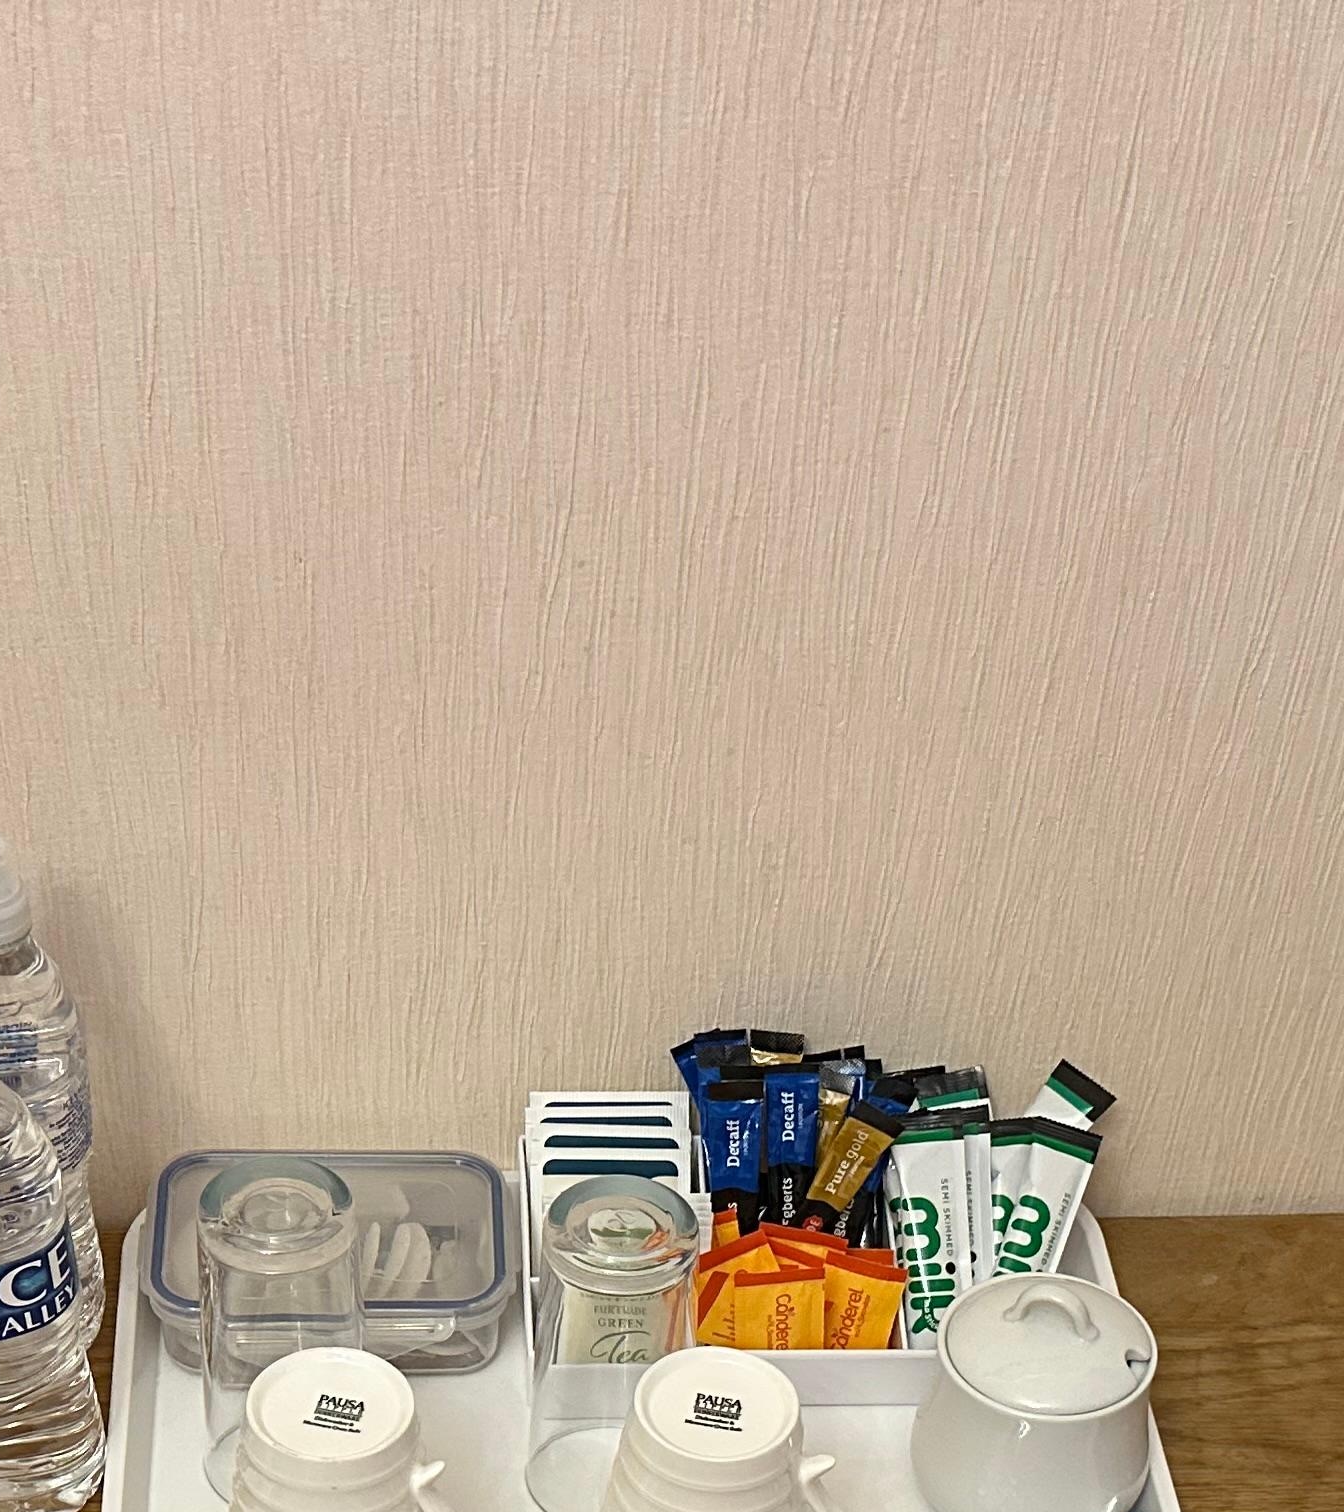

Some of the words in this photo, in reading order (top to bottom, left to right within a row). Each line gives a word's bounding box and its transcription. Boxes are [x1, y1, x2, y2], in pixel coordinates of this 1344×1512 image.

[781, 1092, 795, 1142] Decaff
[727, 1120, 740, 1167] Decaff
[825, 1160, 850, 1195] Pure
[846, 1128, 869, 1160] gold
[1059, 1192, 1071, 1216] SEMI
[943, 1208, 953, 1256] SKIMMED
[1041, 1220, 1061, 1265] SKIMMED
[904, 1197, 955, 1334] milk
[597, 1318, 644, 1329] GREEN
[776, 1294, 792, 1350] Candere
[589, 1330, 651, 1364] Tea
[319, 1394, 365, 1412] PAUSA
[696, 1393, 742, 1410] PAUSA
